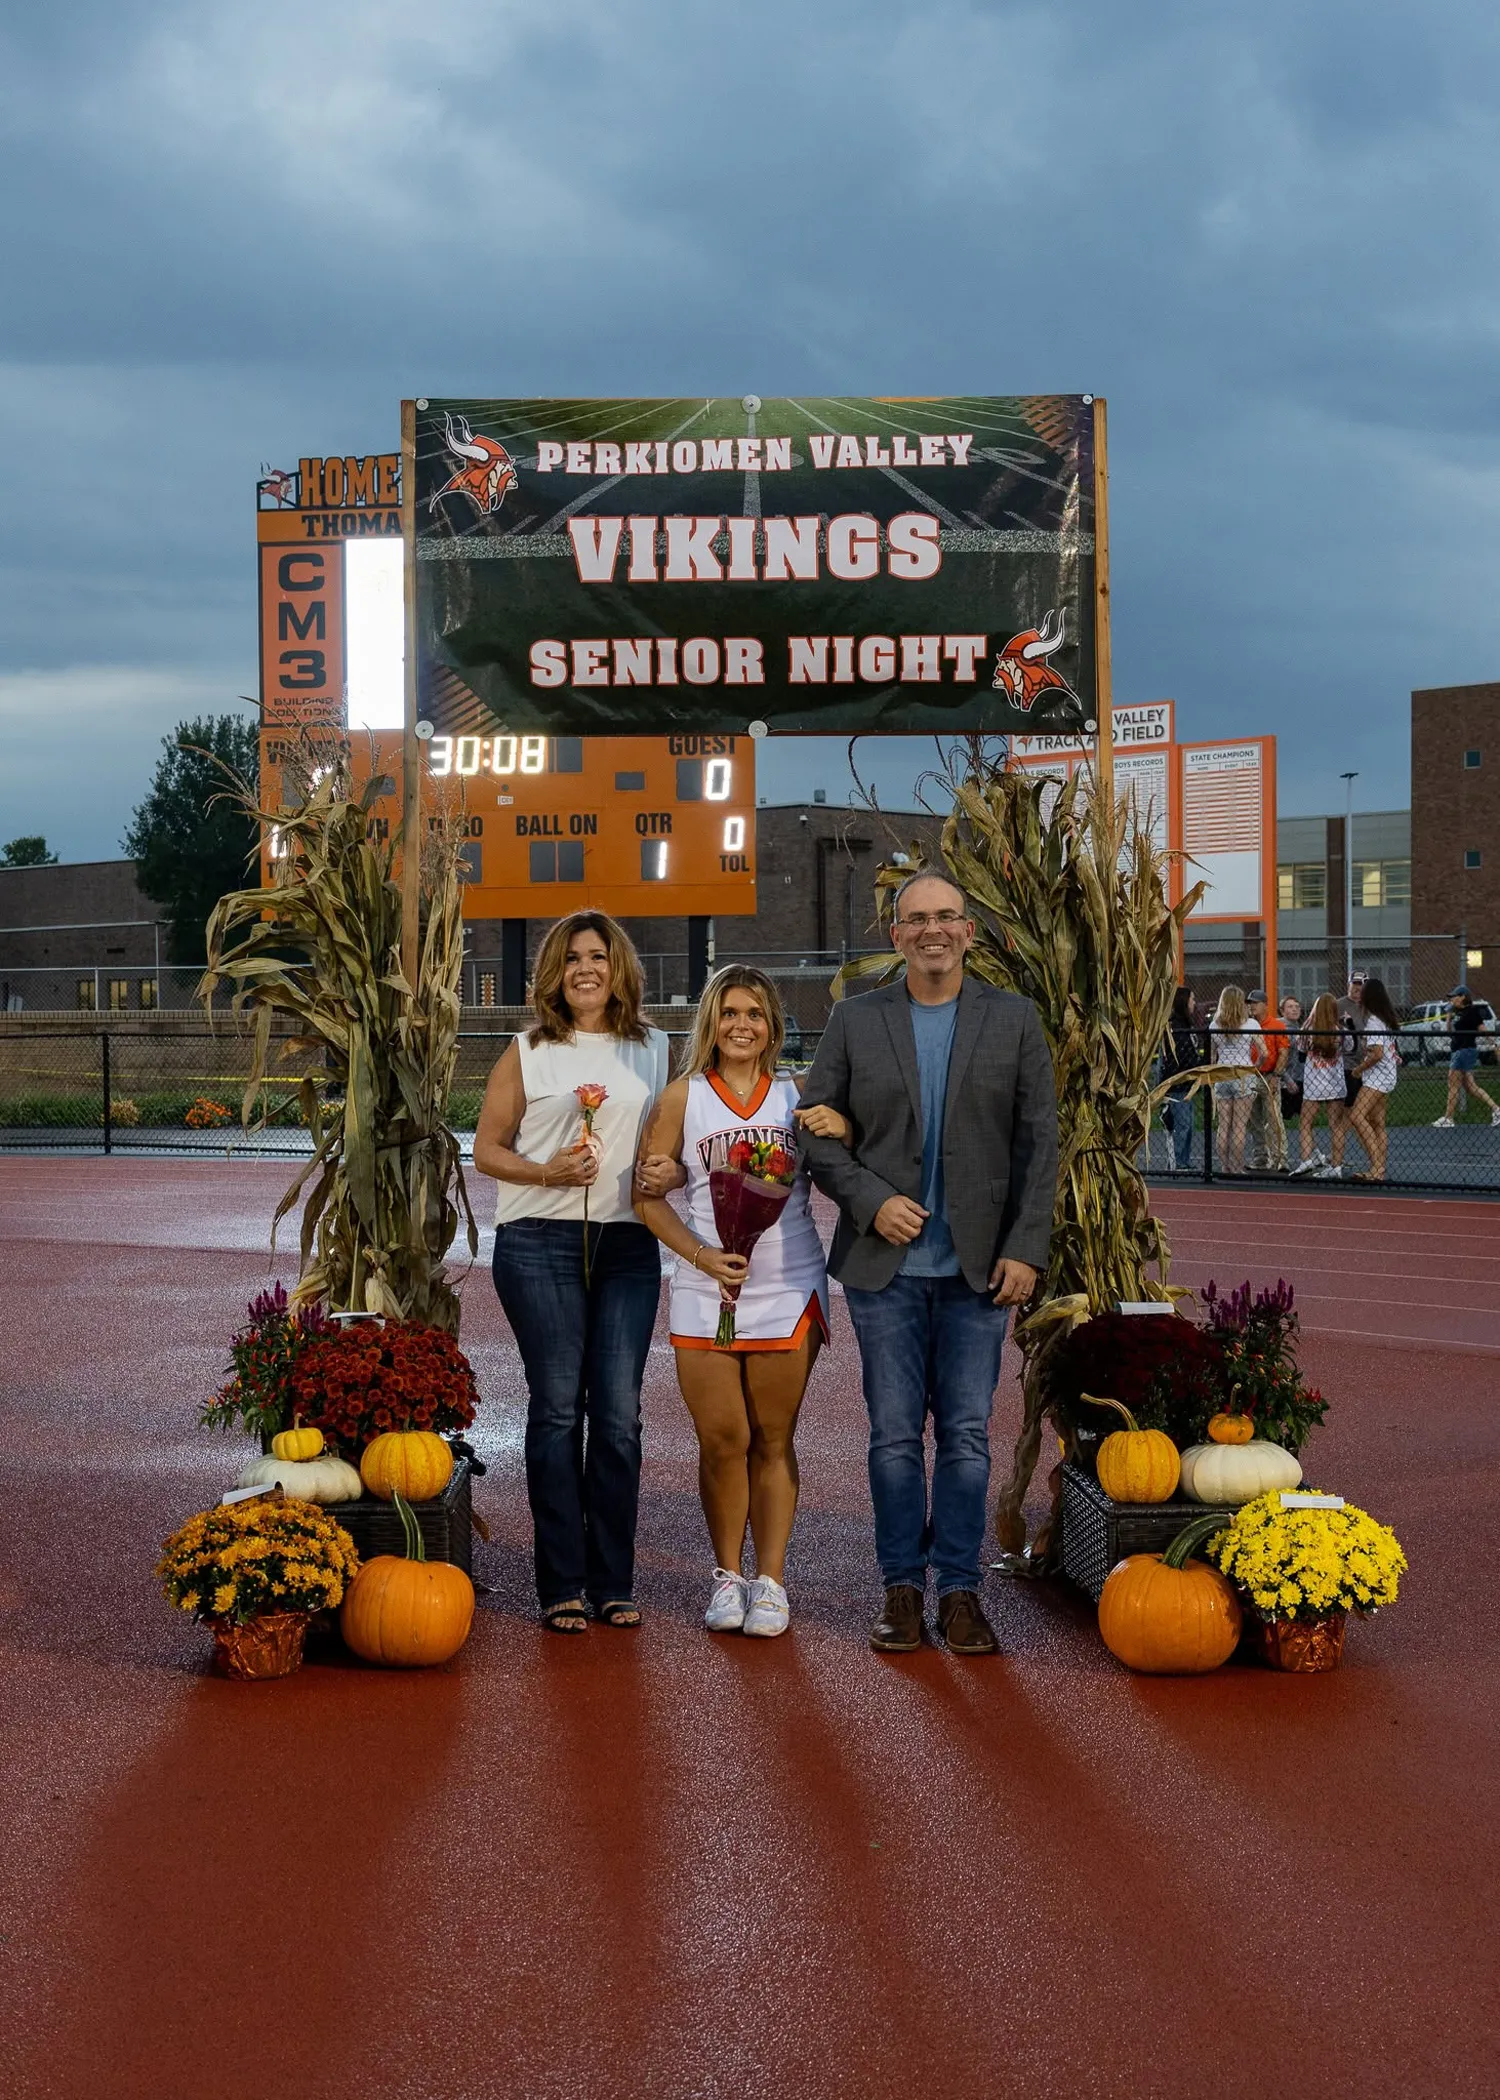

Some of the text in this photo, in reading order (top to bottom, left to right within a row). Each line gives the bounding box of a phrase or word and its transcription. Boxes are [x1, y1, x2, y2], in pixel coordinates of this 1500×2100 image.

[536, 434, 974, 475] PERKIOMEN VALLEY
[299, 455, 400, 508] HOME
[567, 513, 943, 583] VIKINGS
[528, 634, 988, 688] SENIOR NIGHT
[1113, 709, 1166, 725] VALLEY
[668, 736, 735, 756] GUEST
[1036, 734, 1084, 751] TRACK
[1122, 724, 1166, 743] FIELD
[429, 736, 546, 776] 30:08
[1132, 758, 1164, 768] RECORDS
[1190, 750, 1255, 762] STATE CHAMPIONS
[705, 758, 732, 801] 0
[515, 814, 597, 836] BALL ON
[634, 812, 673, 836] QTR
[723, 816, 745, 852] 0
[657, 841, 668, 880] 1
[719, 854, 749, 872] TOL
